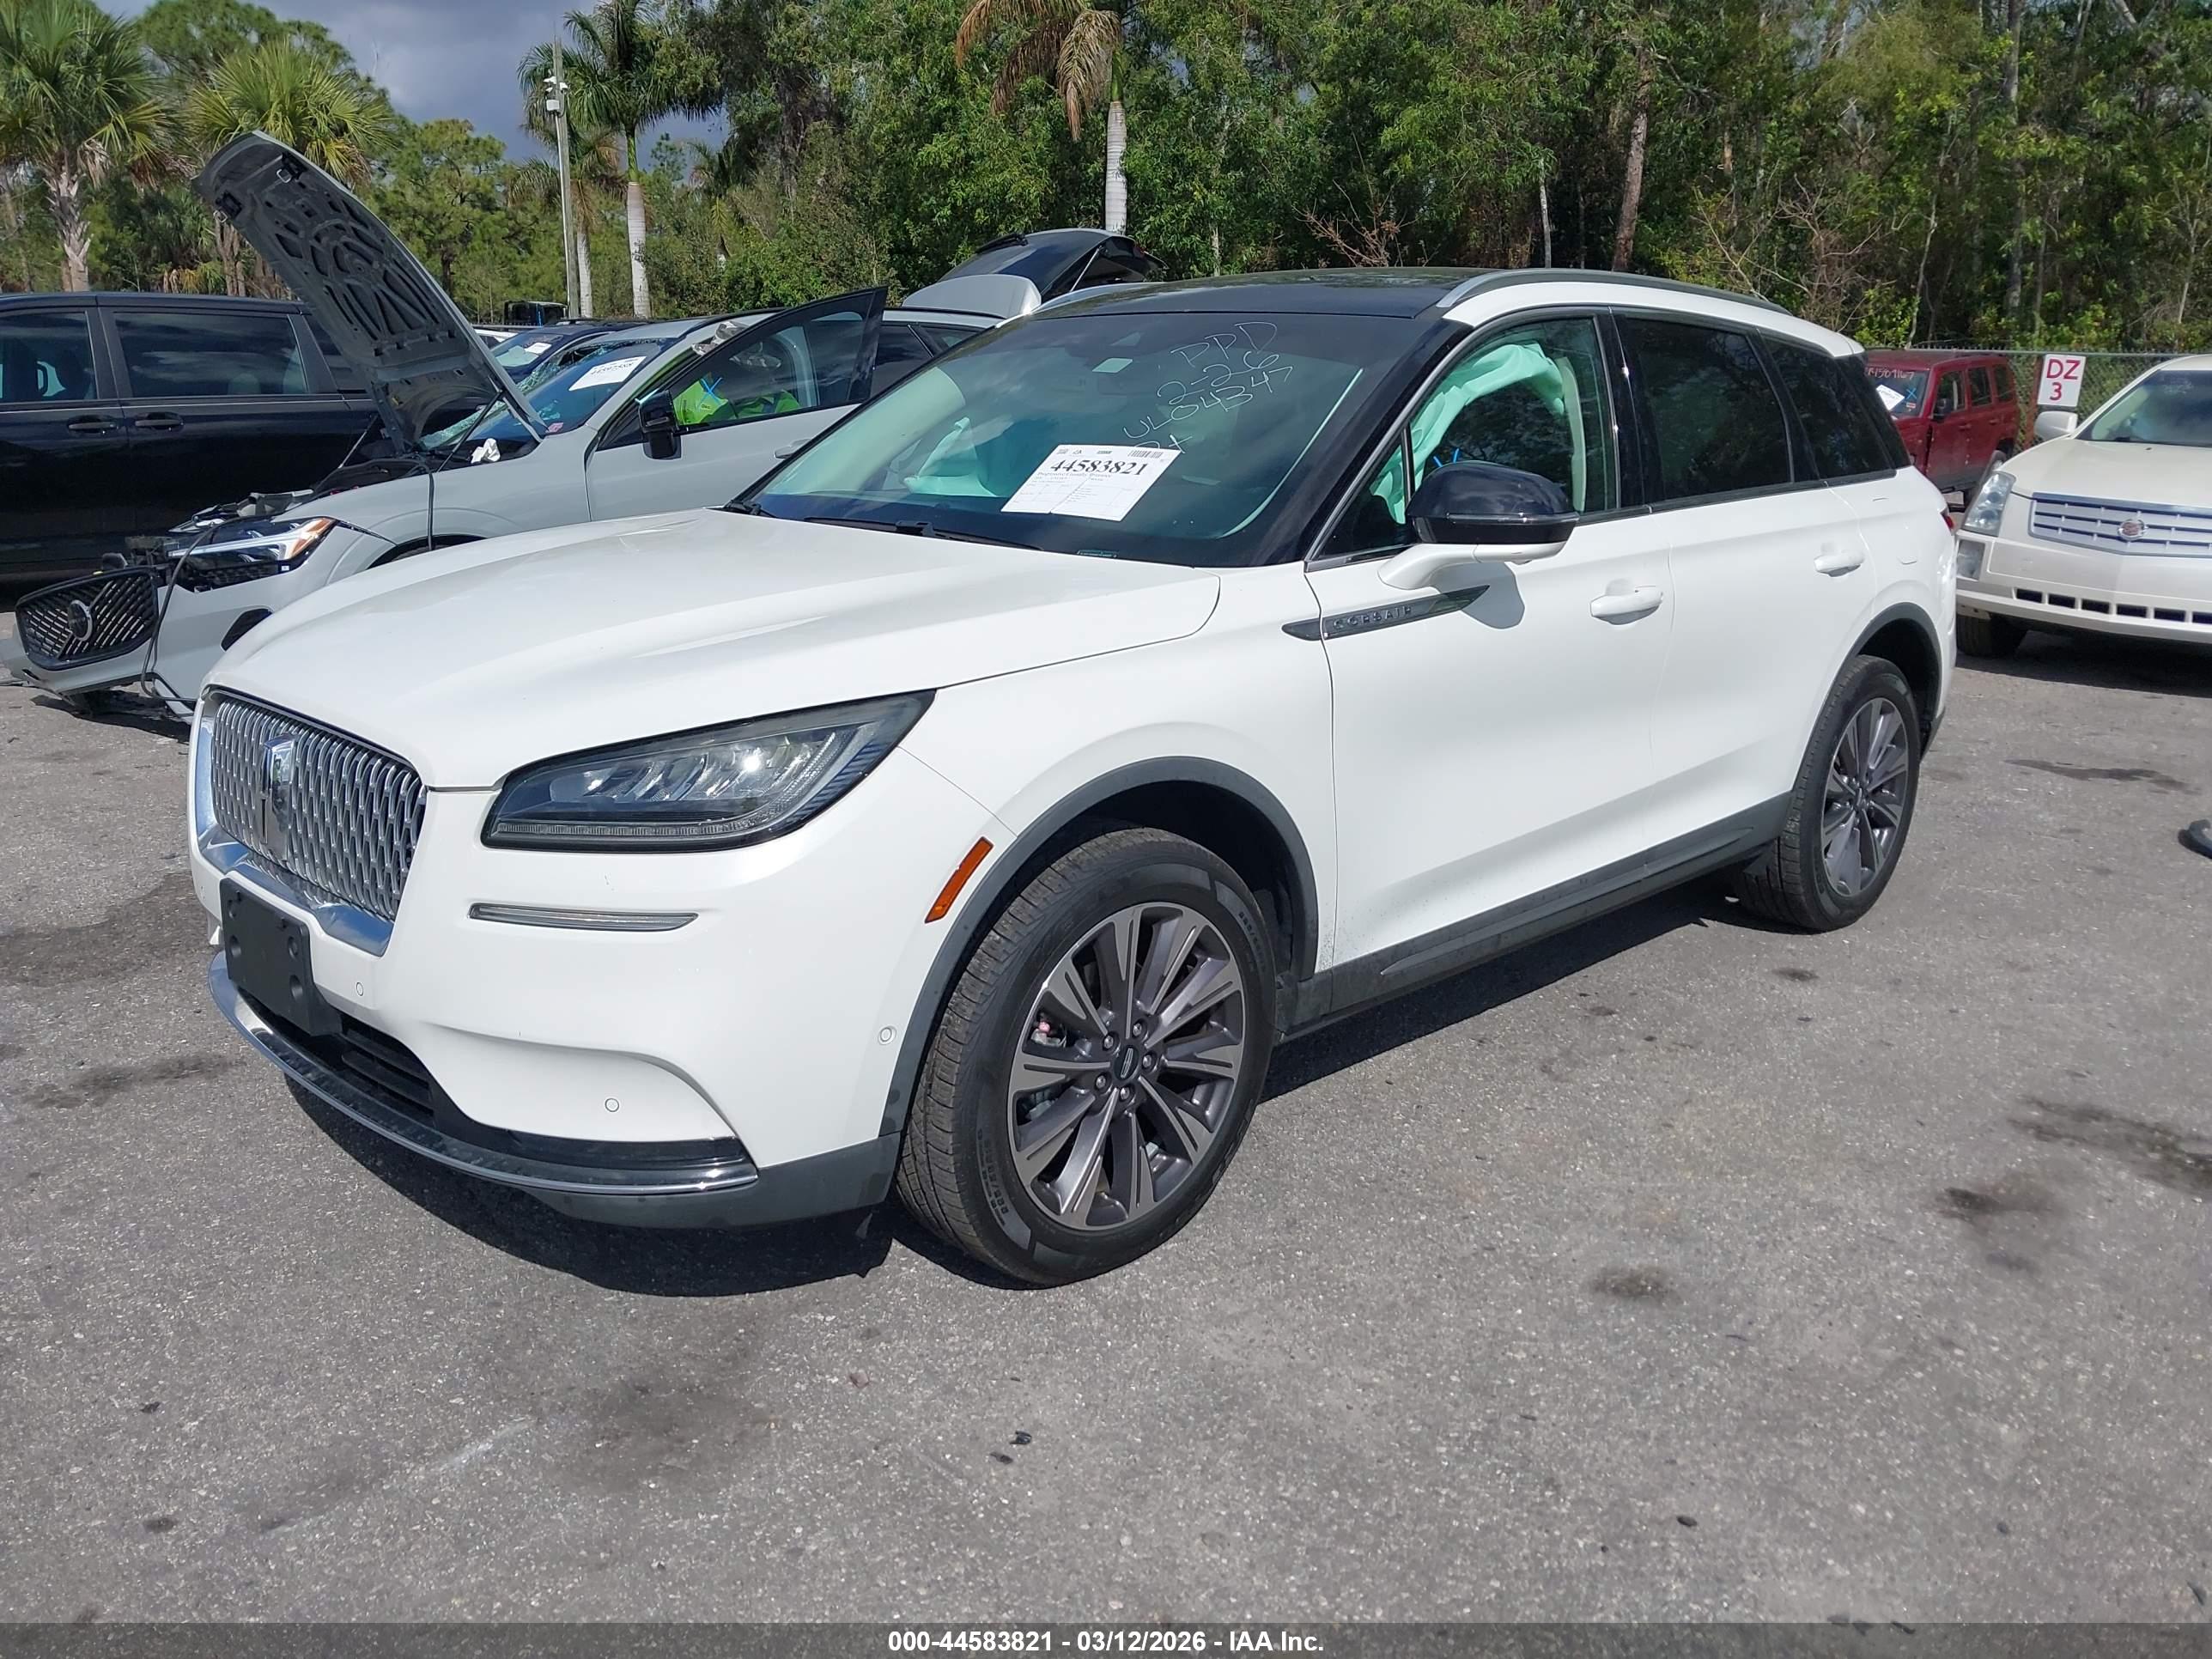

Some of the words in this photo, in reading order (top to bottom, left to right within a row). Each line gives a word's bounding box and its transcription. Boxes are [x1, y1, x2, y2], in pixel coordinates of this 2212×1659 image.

[2046, 358, 2081, 380] DZ
[2050, 381, 2063, 401] 3
[1050, 459, 1148, 476] 44583821
[1333, 605, 1412, 629] CORSAIR
